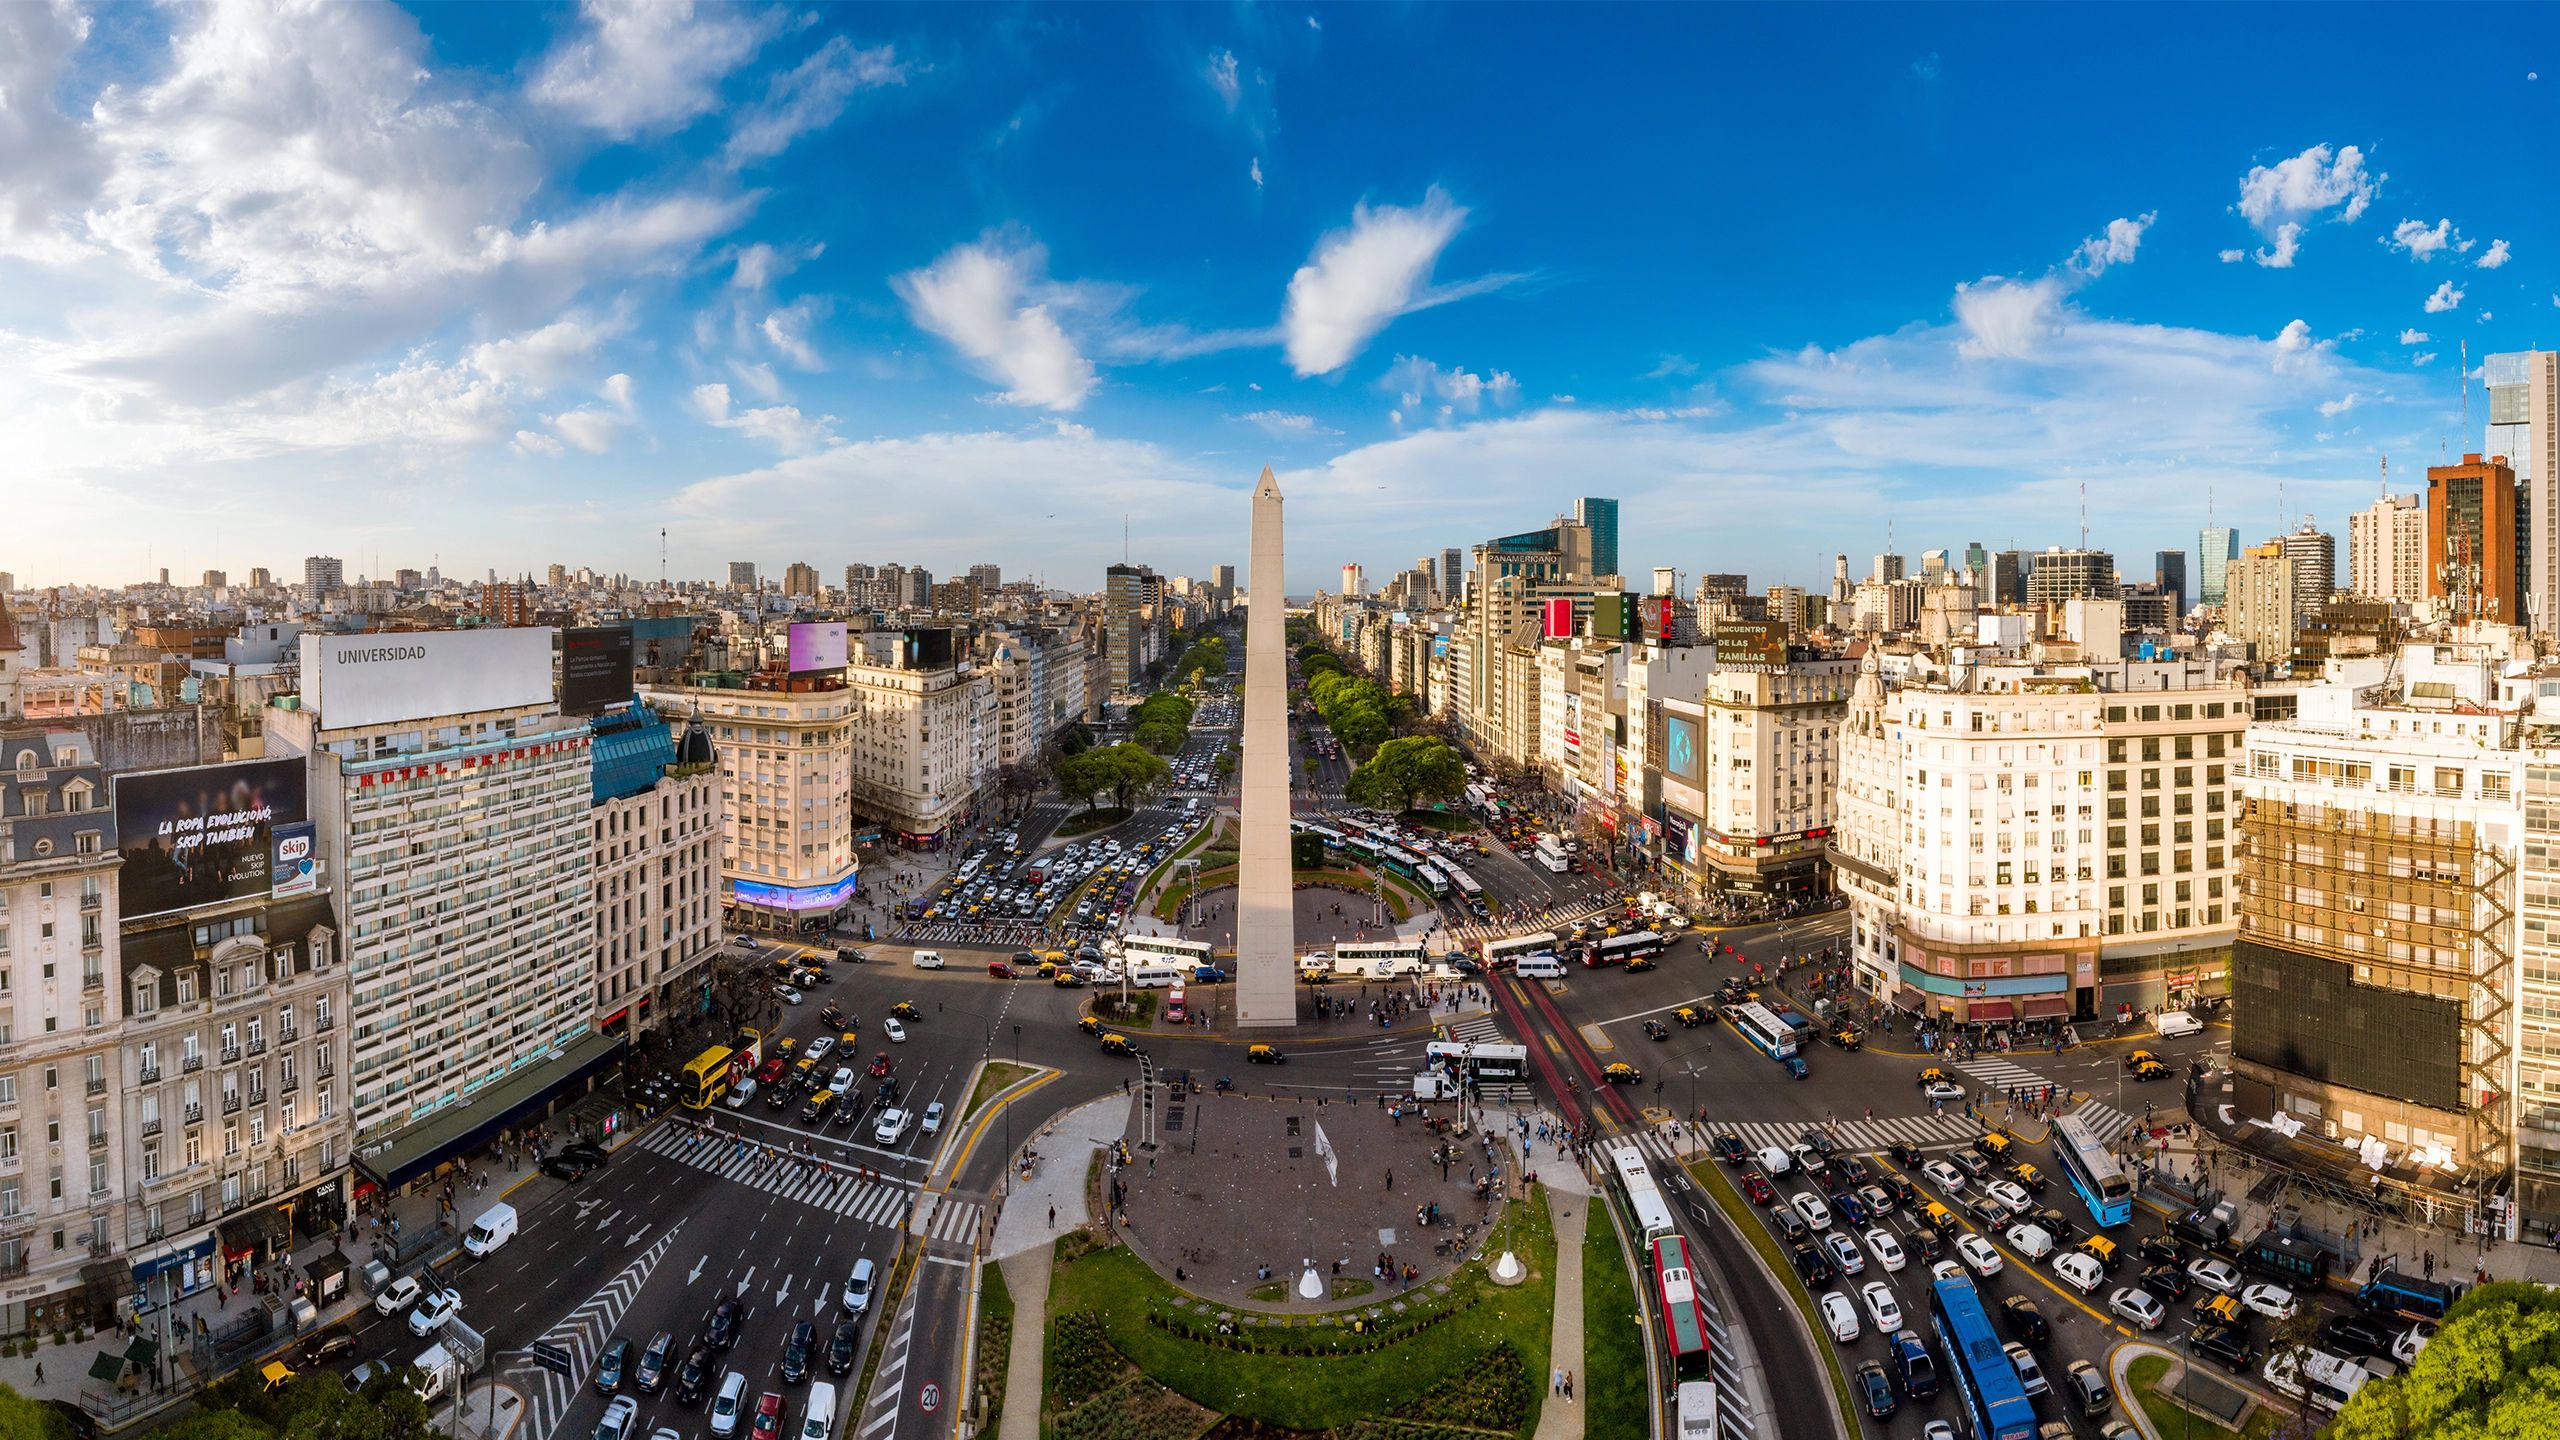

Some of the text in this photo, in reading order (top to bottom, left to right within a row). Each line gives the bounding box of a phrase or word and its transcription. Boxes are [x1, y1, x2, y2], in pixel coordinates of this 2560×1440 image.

[1488, 555, 1557, 563] PANAMERICANO
[338, 646, 426, 664] UNIVERSIDAD
[1718, 652, 1766, 661] FAMILIAS
[361, 736, 591, 787] HOTEL REPUBLICA
[158, 821, 172, 836] LA
[176, 817, 204, 833] ROPA
[1644, 822, 1654, 833] KFC
[176, 827, 255, 849] SKIP TAMBIÉN
[1772, 833, 1801, 843] ABOGADOS
[241, 840, 306, 864] NUEVO skip
[250, 861, 265, 870] SKIP
[228, 869, 265, 882] EVOLUTION
[811, 893, 832, 905] LINIO
[317, 1181, 336, 1194] CANAL
[1944, 1336, 1979, 1422] ANDESMAR
[923, 1388, 938, 1407] 20
